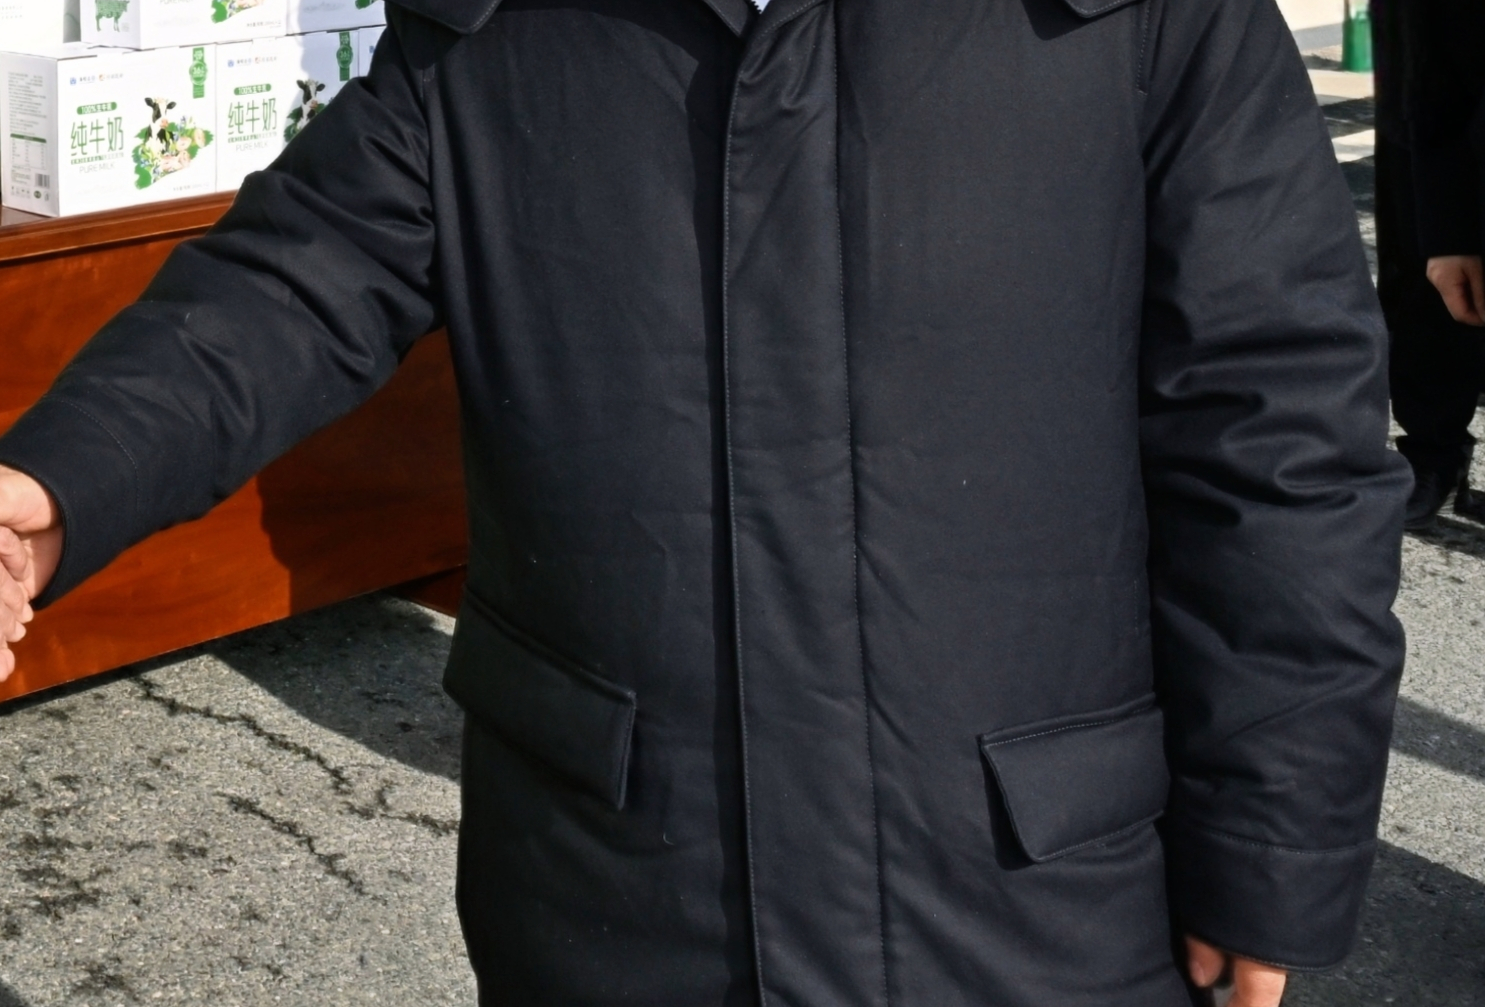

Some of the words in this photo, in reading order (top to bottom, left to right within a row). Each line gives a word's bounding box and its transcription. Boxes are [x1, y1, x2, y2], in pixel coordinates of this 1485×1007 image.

[228, 97, 277, 135] 纯牛奶
[71, 116, 124, 156] 纯牛奶
[79, 165, 98, 174] PURE
[98, 162, 116, 172] MILK
